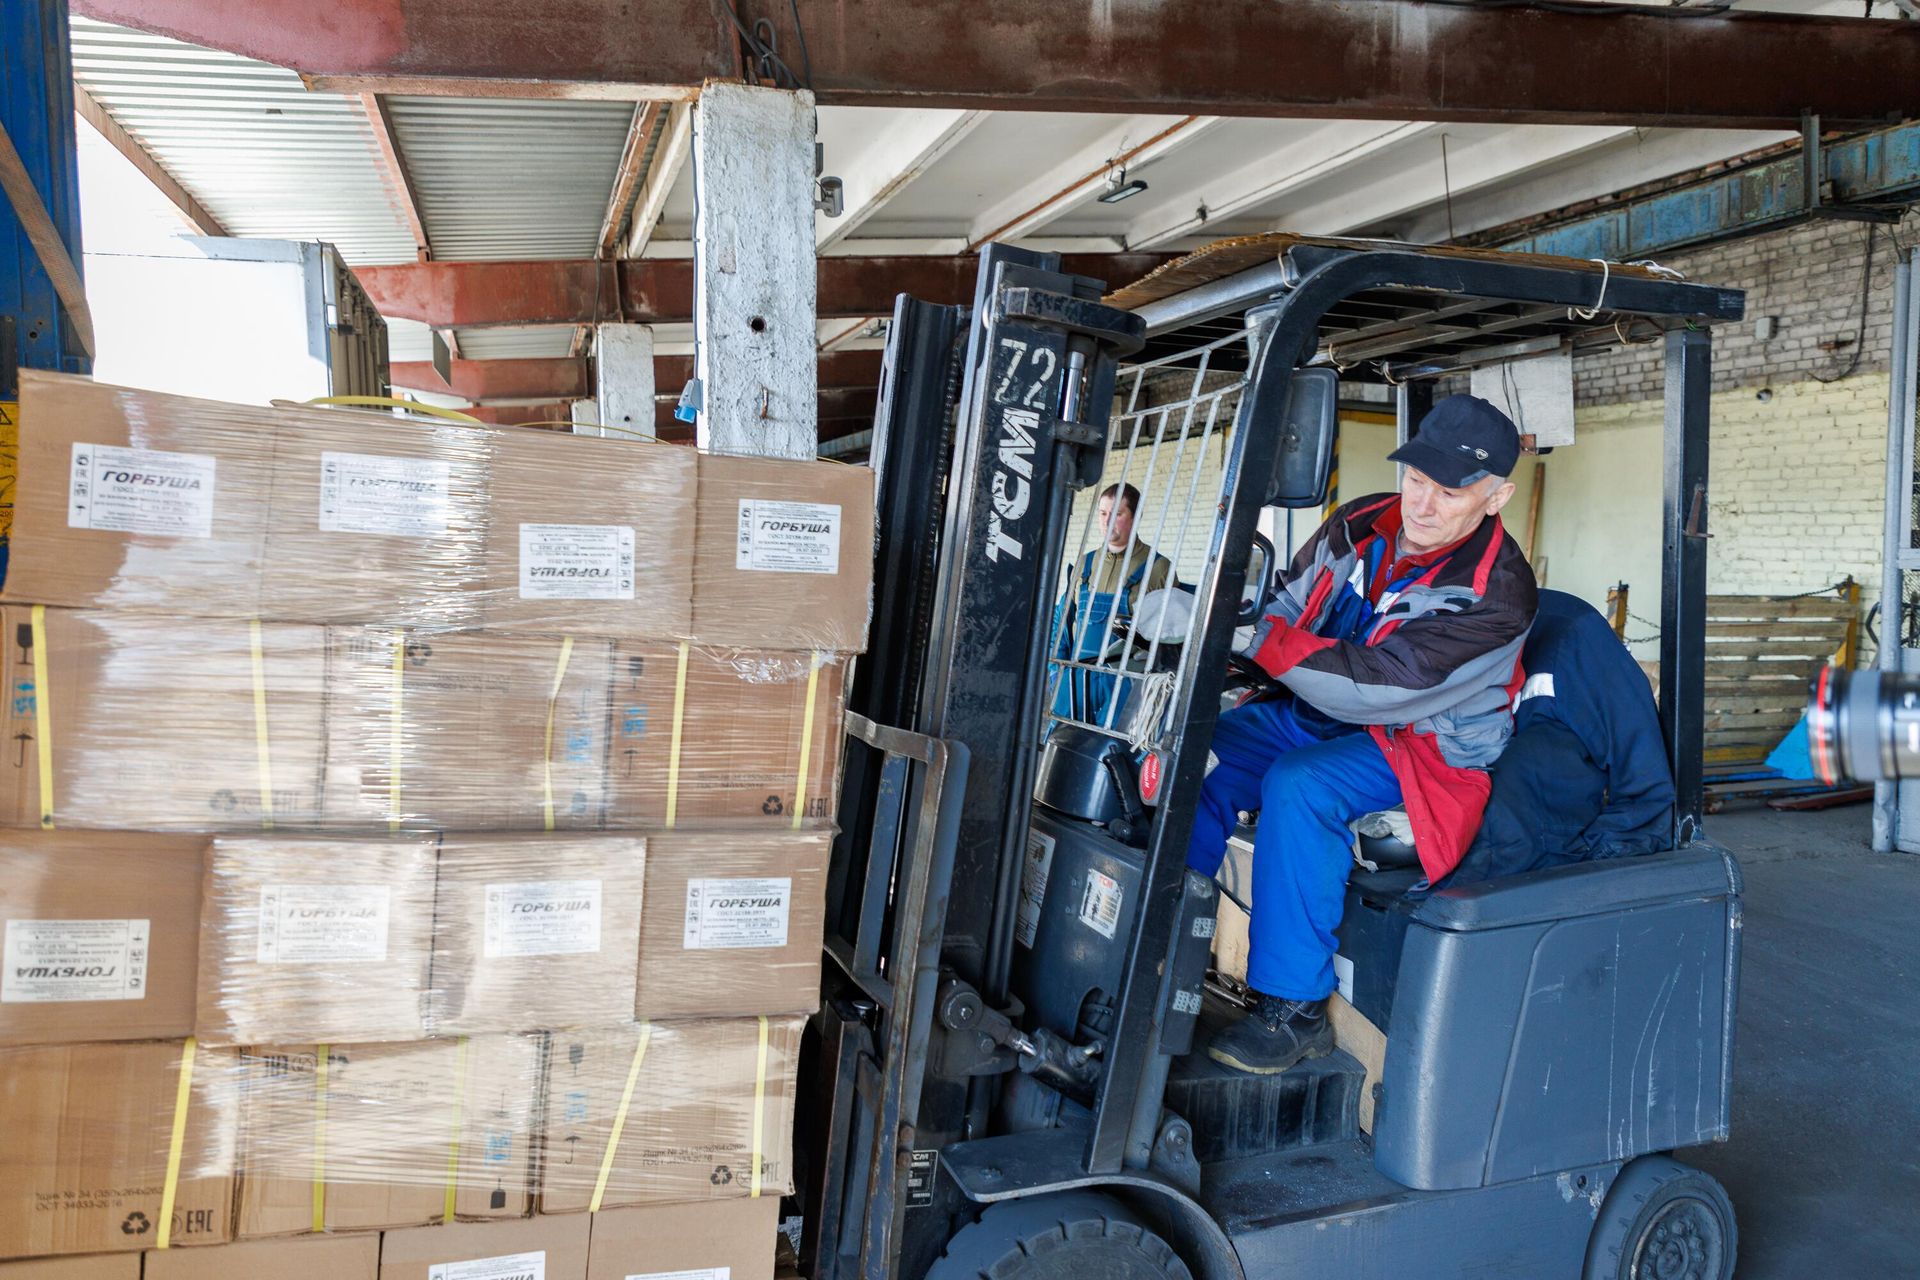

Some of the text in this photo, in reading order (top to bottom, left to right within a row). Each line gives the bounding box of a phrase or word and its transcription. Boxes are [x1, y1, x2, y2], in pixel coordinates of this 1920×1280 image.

[995, 337, 1057, 410] 72
[102, 470, 201, 490] ГОРБУША
[985, 408, 1040, 563] TCM
[761, 520, 831, 534] ГОРБУША
[530, 567, 610, 578] ГОРБУША
[511, 900, 591, 913] ГОРБУША
[710, 898, 781, 909] ГОРБУША
[16, 966, 116, 978] ГОРБУША
